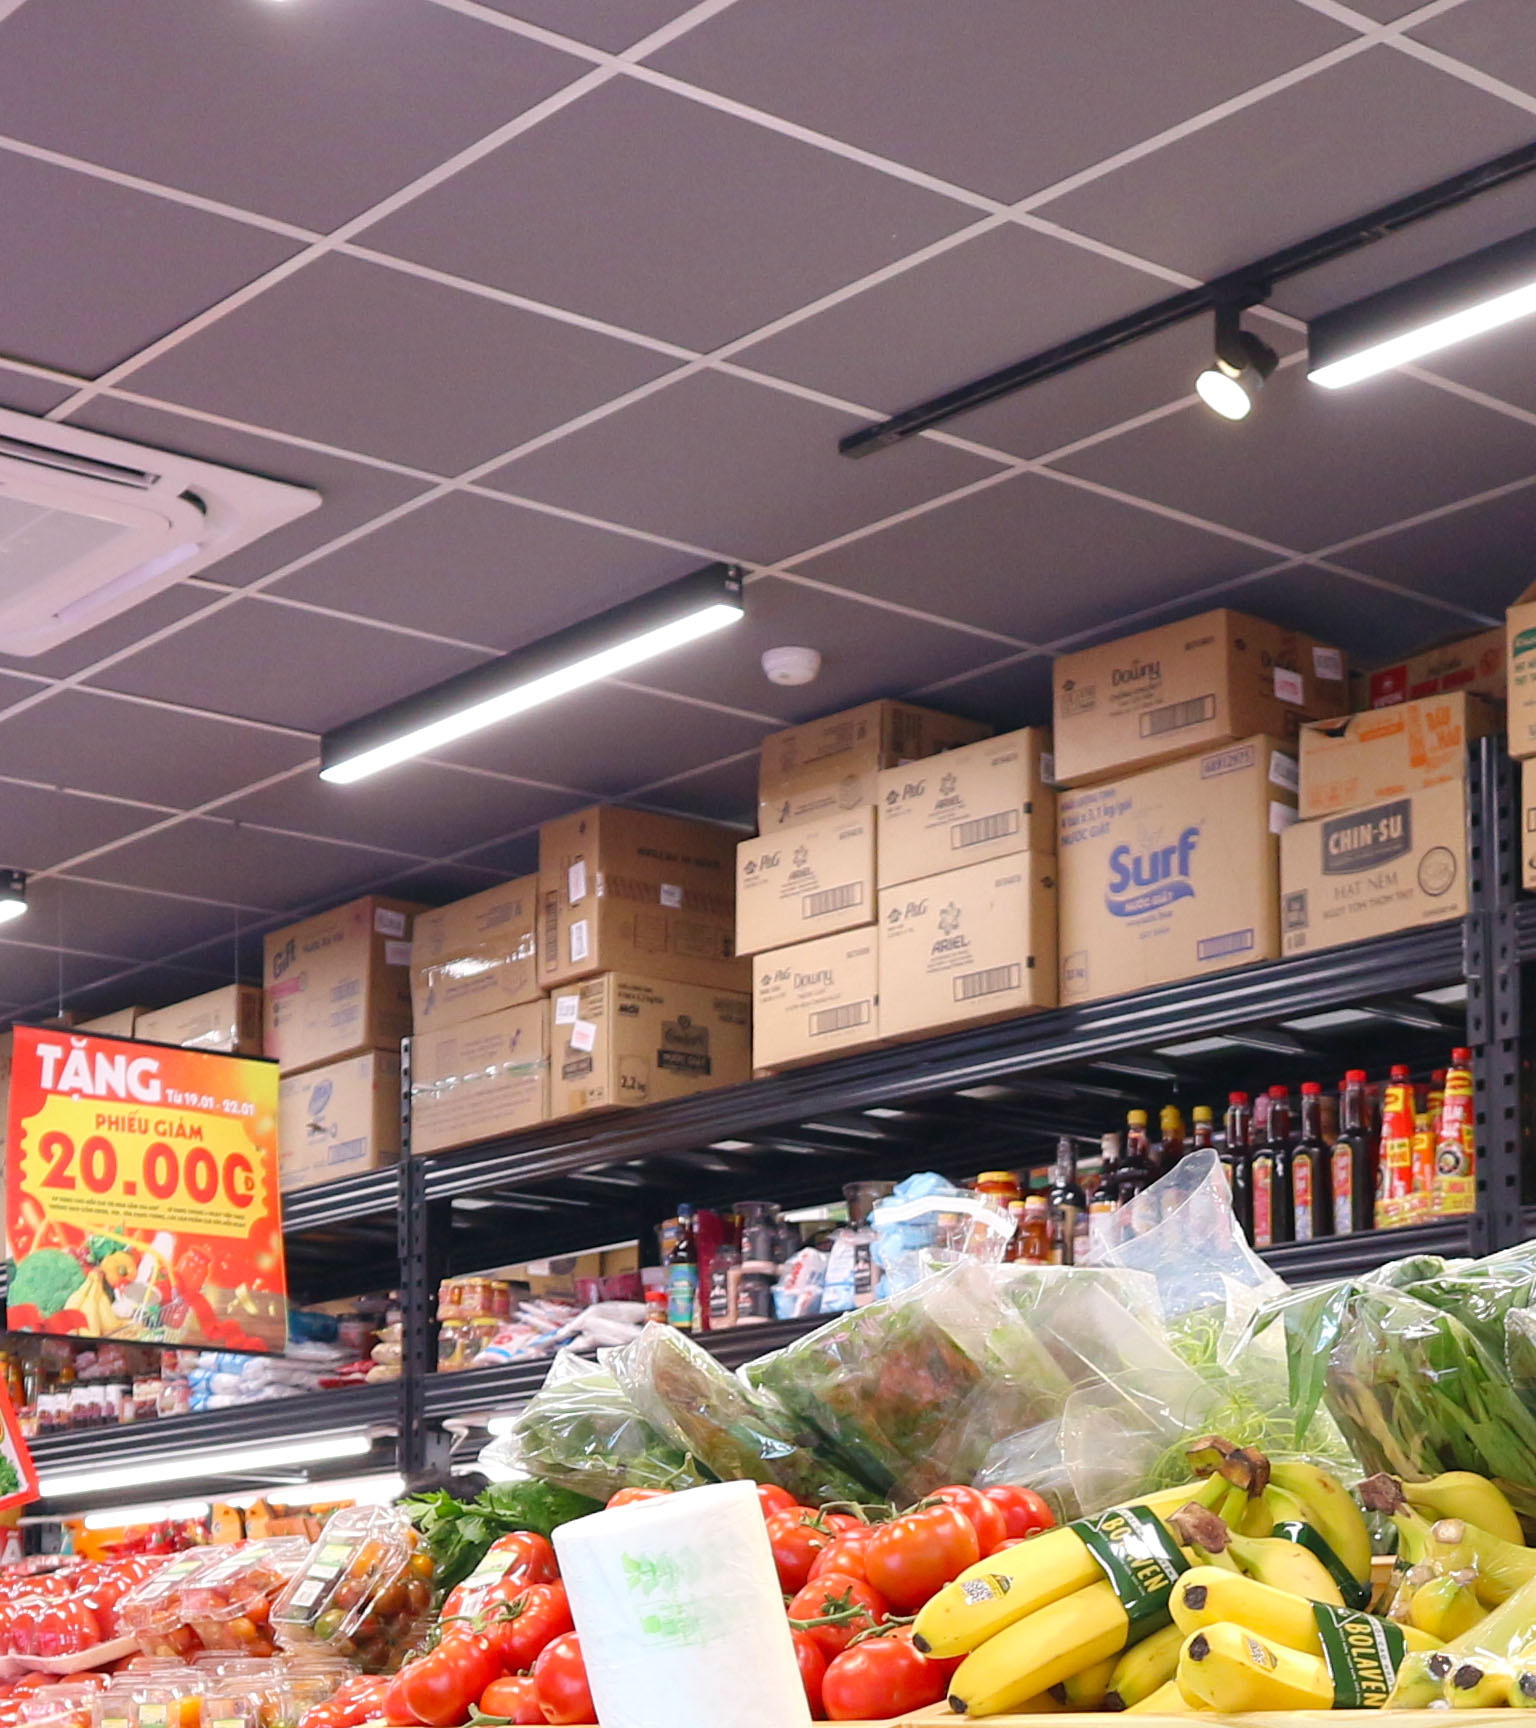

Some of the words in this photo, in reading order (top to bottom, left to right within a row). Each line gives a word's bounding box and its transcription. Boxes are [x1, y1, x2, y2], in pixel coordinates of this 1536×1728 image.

[1111, 658, 1161, 687] Downy
[1328, 813, 1404, 856] CHIN-SU
[1109, 826, 1201, 894] Surf
[793, 967, 835, 991] Downy
[36, 1036, 162, 1103] TẶNG
[95, 1107, 150, 1135] PHIẾU
[154, 1115, 204, 1142] GIẢM
[183, 1092, 216, 1110] 19.01
[222, 1098, 255, 1117] 22.01
[1102, 1516, 1170, 1593] BOVEN
[1344, 1622, 1390, 1707] BOLAVEN
